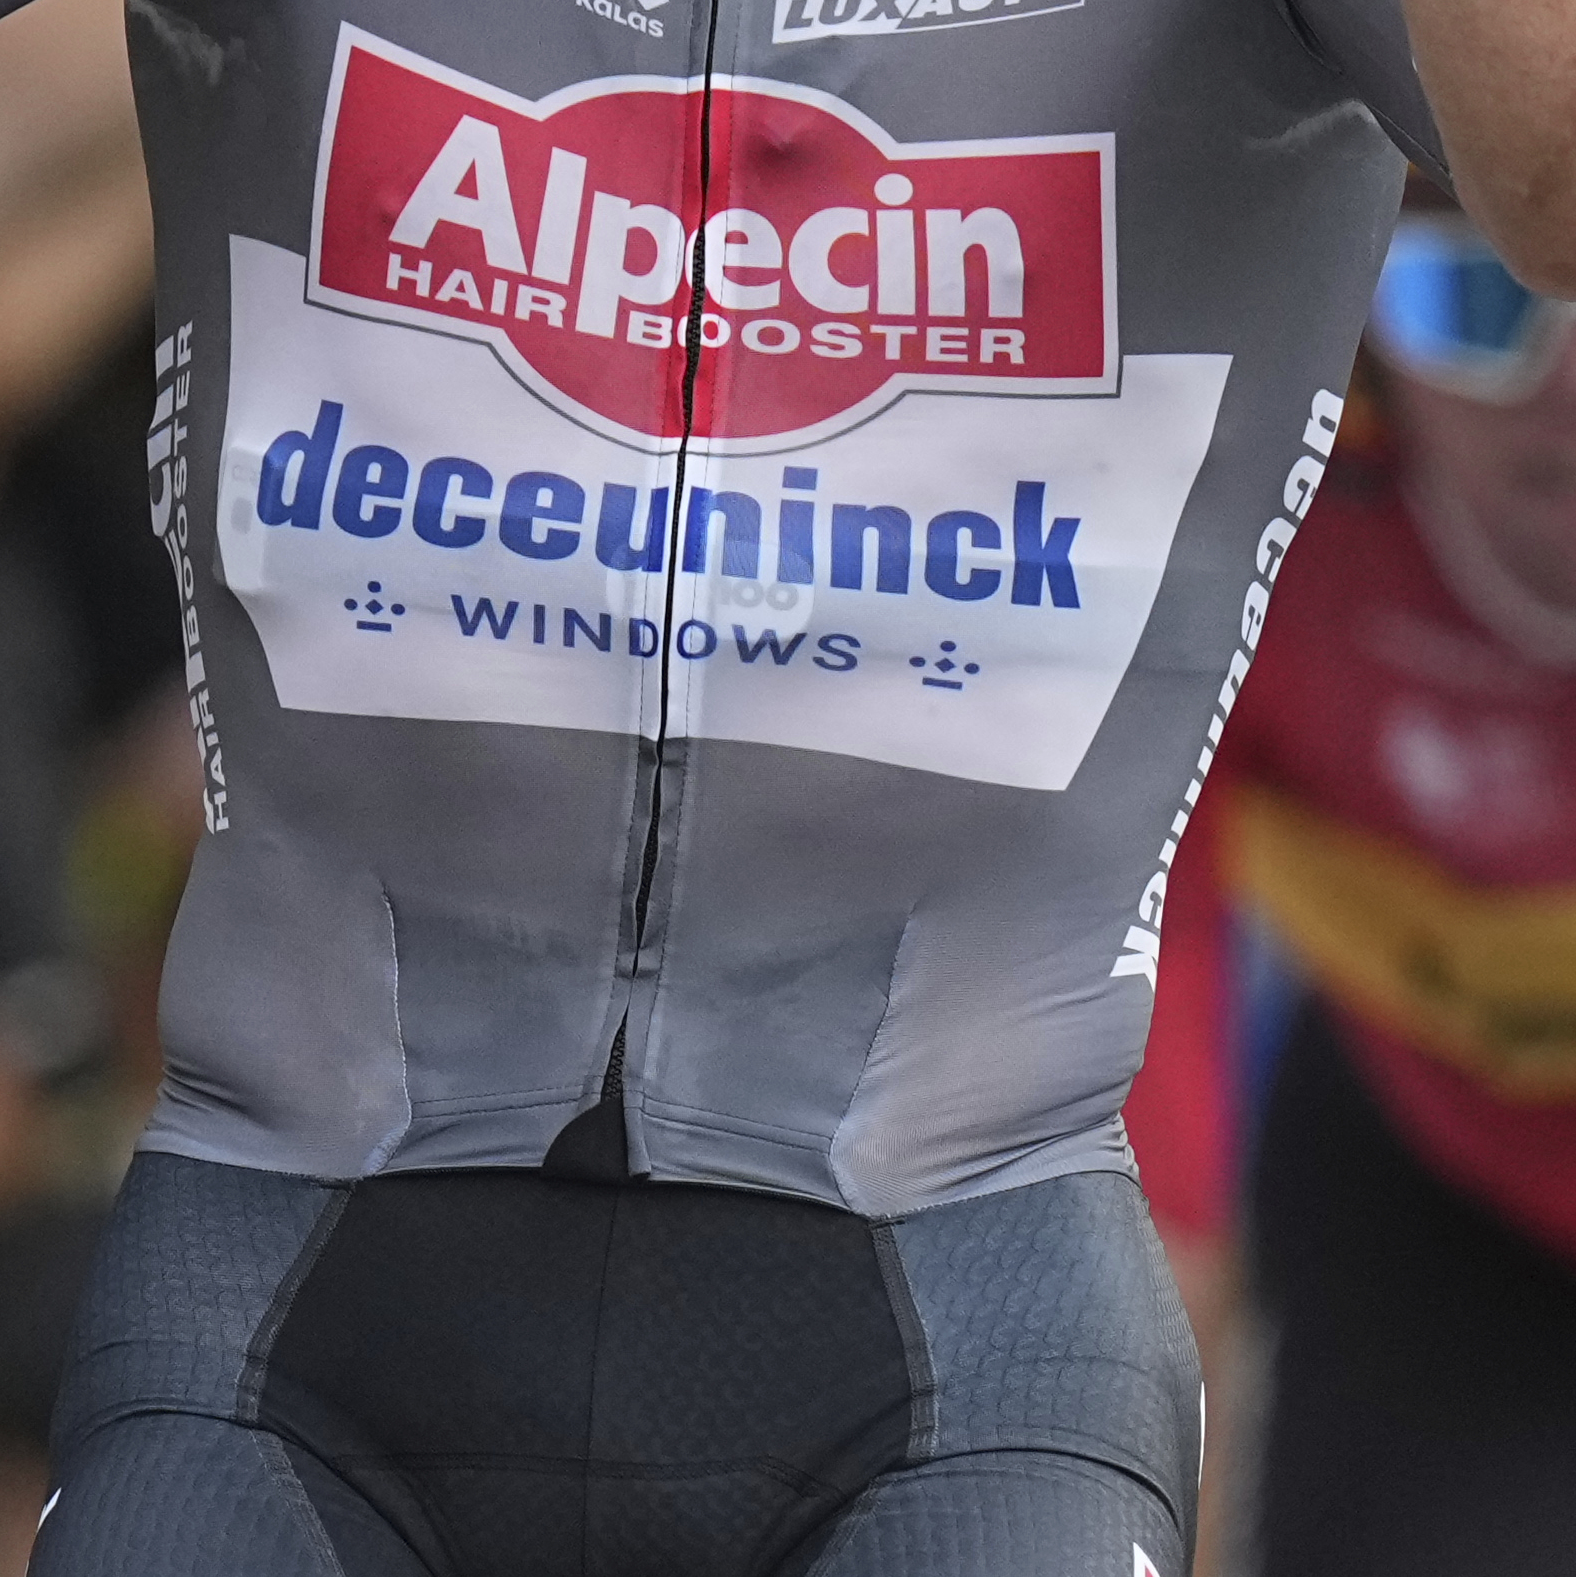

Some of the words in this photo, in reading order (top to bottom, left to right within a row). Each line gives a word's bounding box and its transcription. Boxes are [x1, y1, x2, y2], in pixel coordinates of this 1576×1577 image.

[384, 252, 570, 331] HAIR
[626, 310, 1027, 366] BOOSTER
[387, 113, 1025, 335] Alpecin
[175, 320, 200, 650] BOOSTER
[256, 398, 1082, 611] deceuninck
[450, 593, 861, 673] WINDOWS
